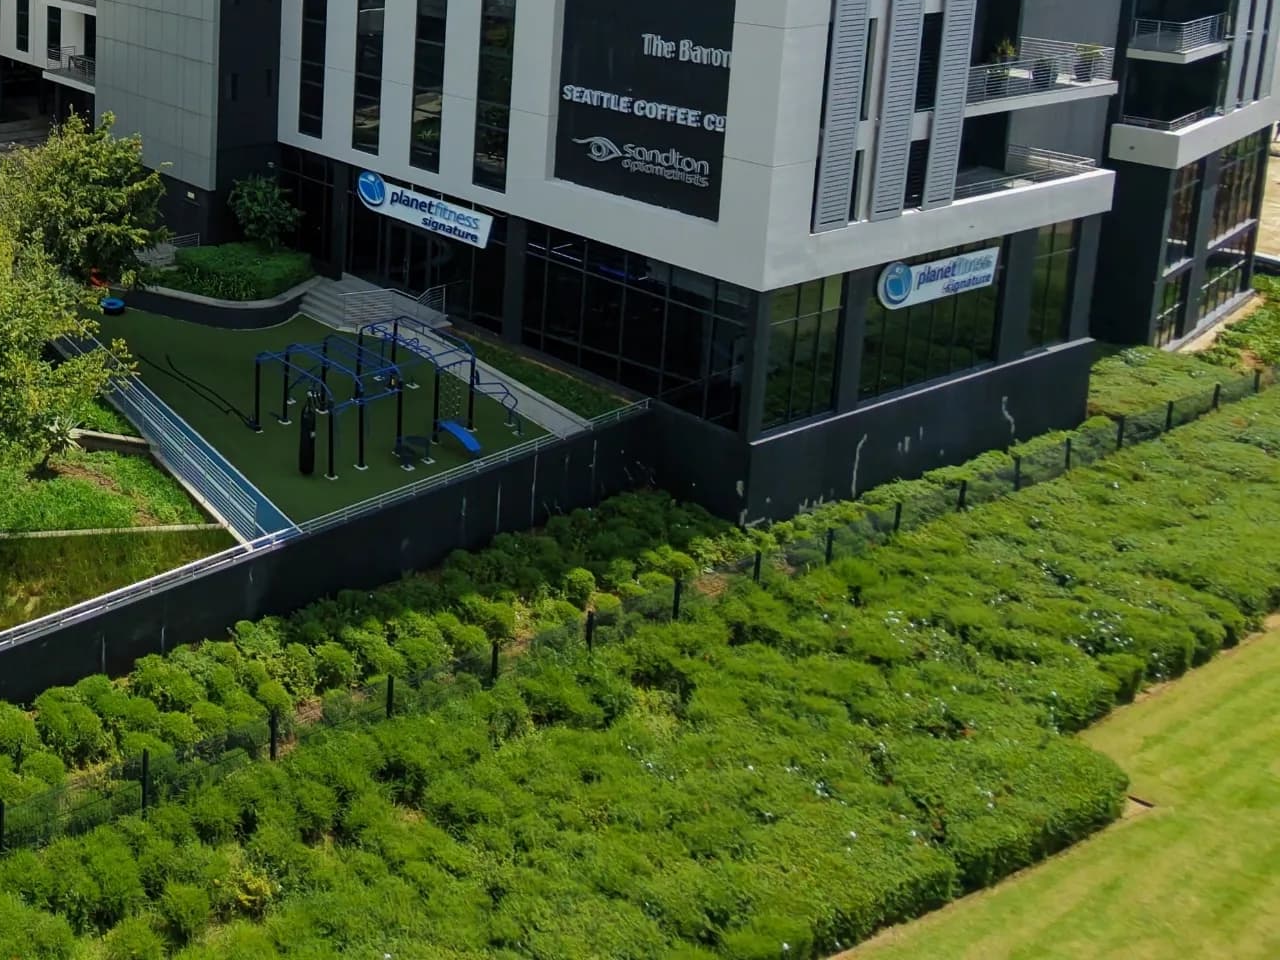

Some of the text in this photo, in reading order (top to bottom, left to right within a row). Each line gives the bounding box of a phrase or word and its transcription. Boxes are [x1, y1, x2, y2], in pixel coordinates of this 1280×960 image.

[641, 33, 676, 58] The
[562, 84, 632, 113] SEATTLE
[634, 99, 701, 127] COFFEE
[622, 144, 709, 175] sandton
[422, 216, 479, 243] signature
